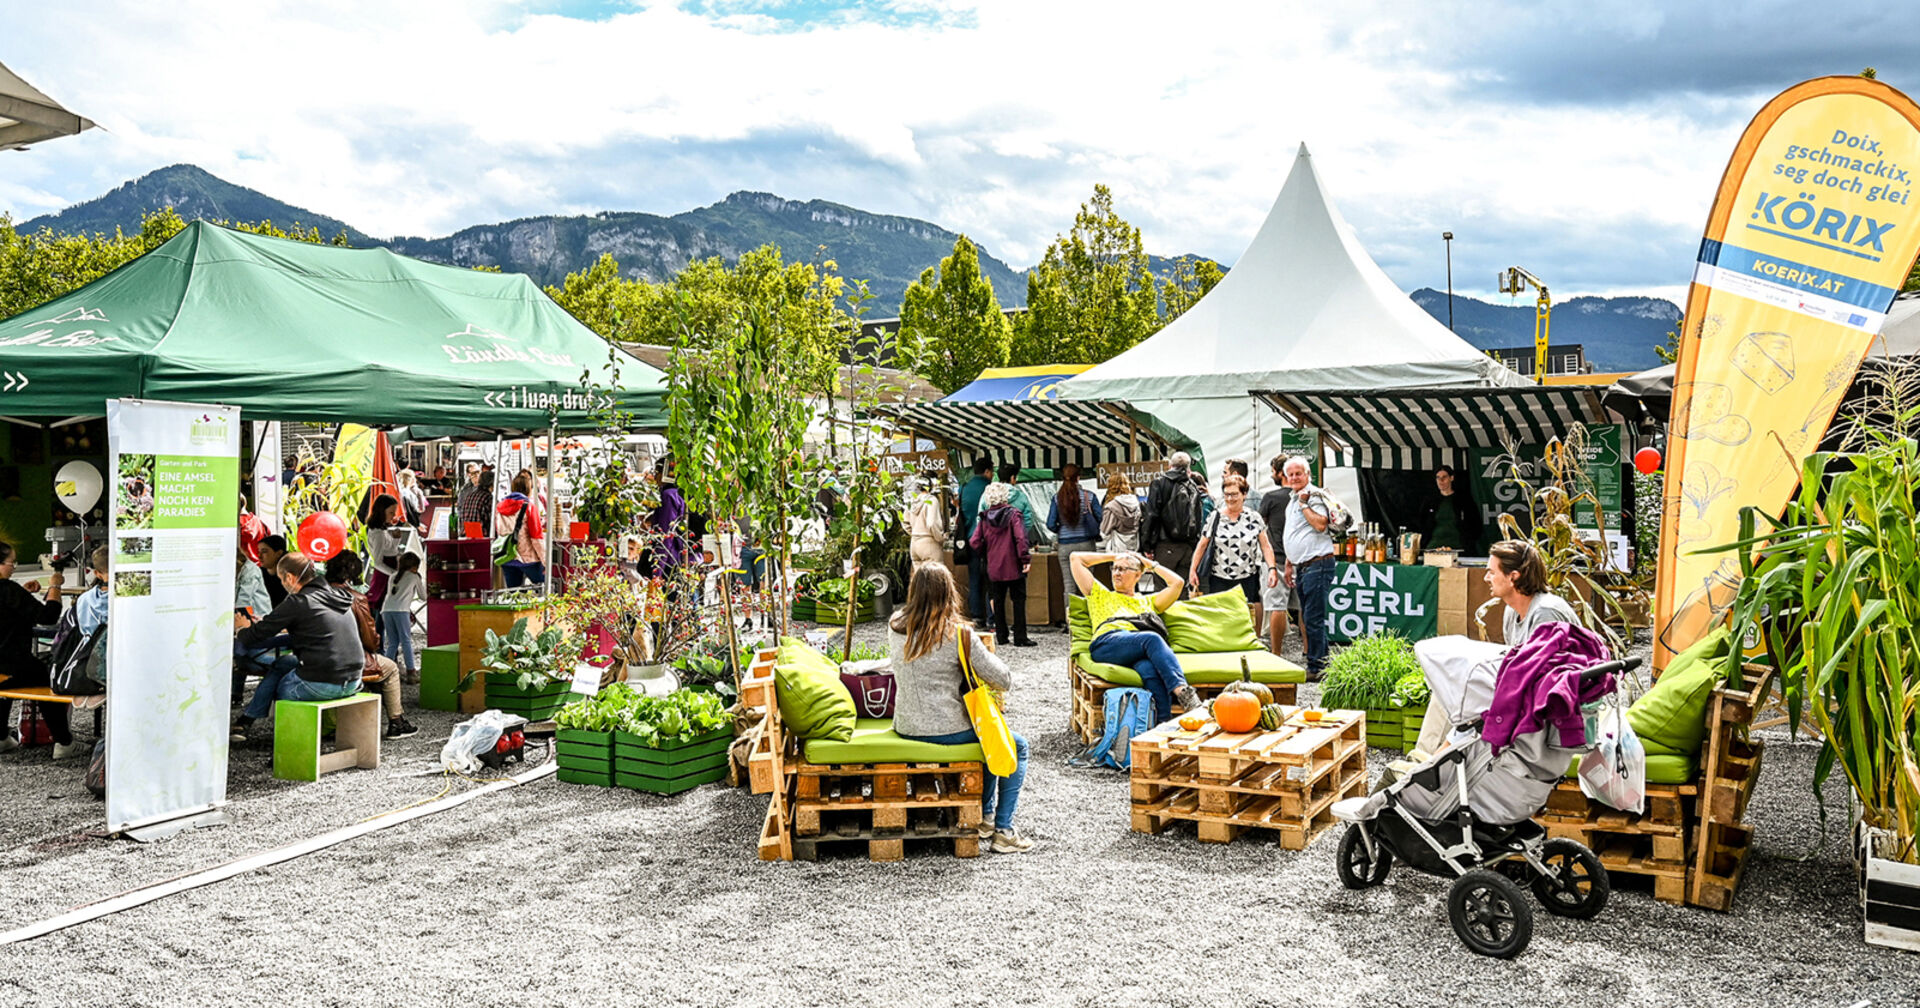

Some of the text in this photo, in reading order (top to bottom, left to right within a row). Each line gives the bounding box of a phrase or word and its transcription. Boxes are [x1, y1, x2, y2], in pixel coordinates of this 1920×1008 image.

[1831, 130, 1883, 157] Doix,
[1784, 145, 1912, 186] gschmackix,
[1773, 163, 1911, 206] seg doch glei
[1752, 259, 1845, 294] KOERIX.AT
[159, 484, 195, 494] MACHT
[160, 472, 216, 482] EINE AMSEL
[158, 496, 214, 506] NOCH KEIN
[158, 507, 206, 517] PARADIES
[1331, 562, 1394, 589] AN
[1328, 587, 1425, 617] GERL
